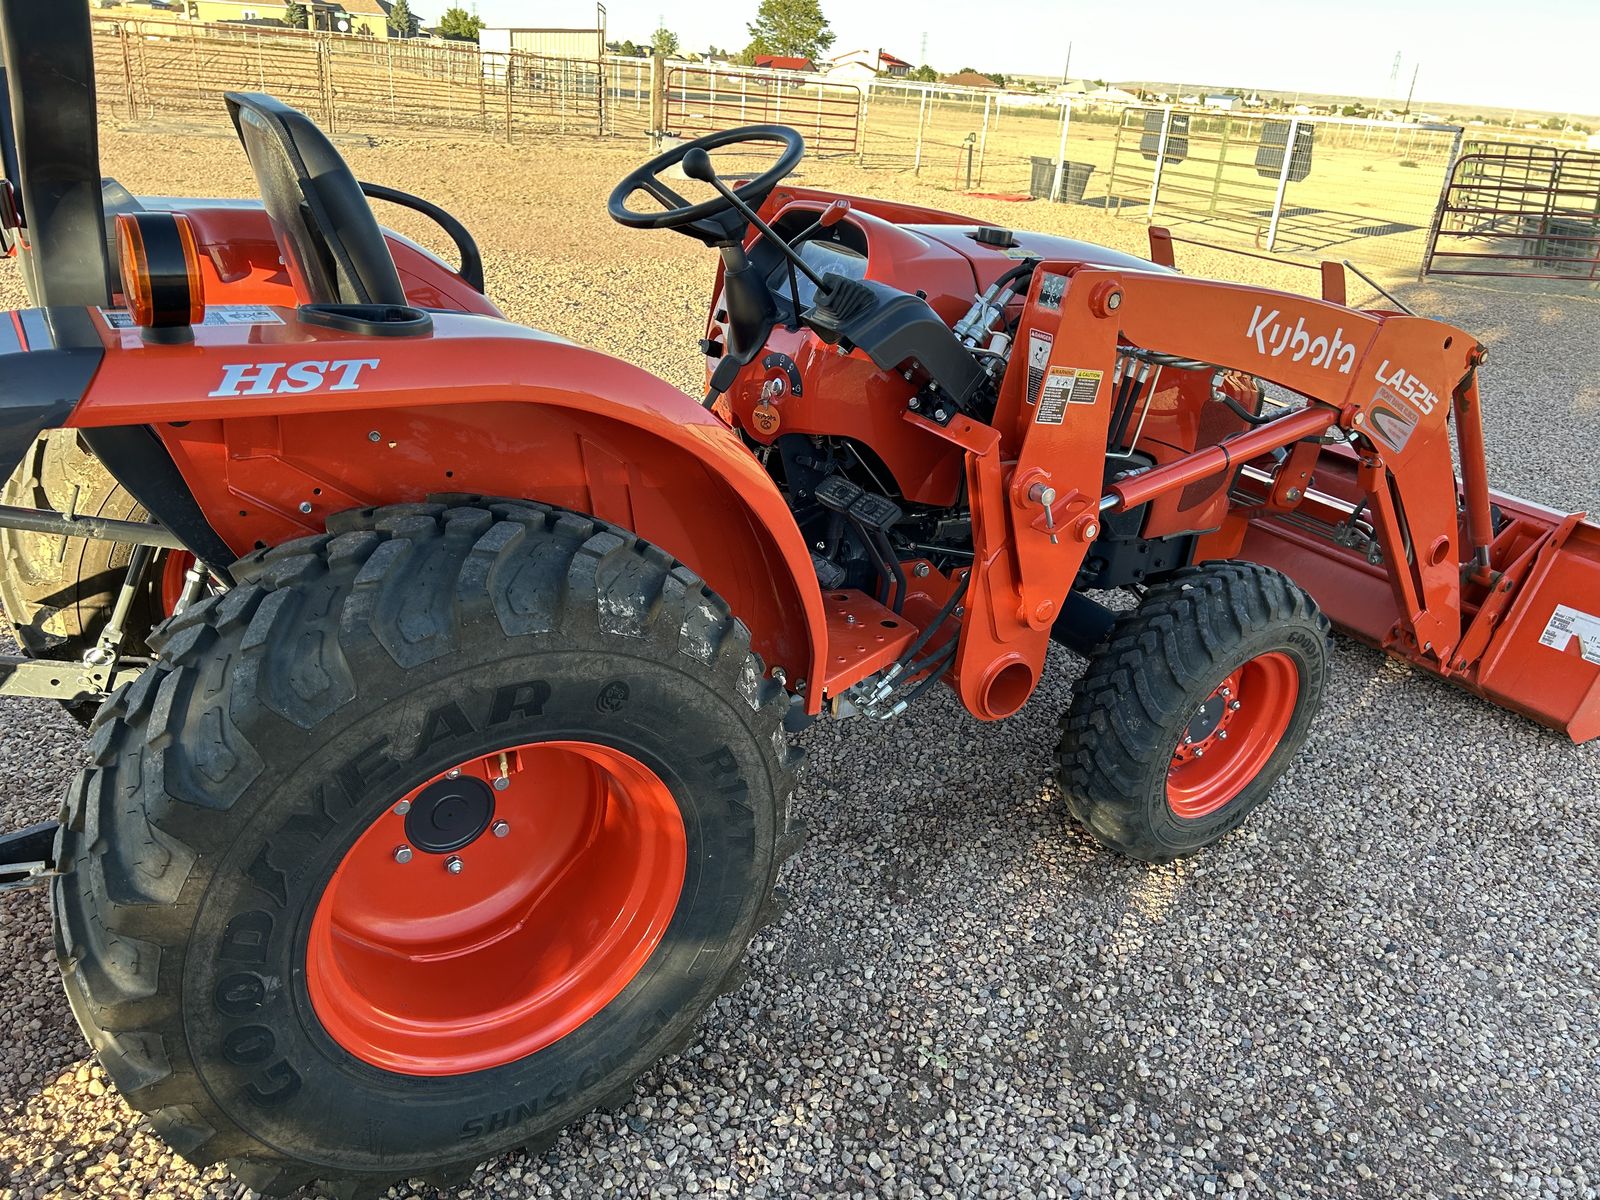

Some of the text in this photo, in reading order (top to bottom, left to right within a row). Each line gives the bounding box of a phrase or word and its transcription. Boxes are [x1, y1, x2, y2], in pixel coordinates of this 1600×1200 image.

[1246, 305, 1356, 374] Kubota
[208, 358, 380, 397] HST
[1055, 368, 1074, 376] WARNING
[1375, 360, 1439, 415] LA525
[215, 679, 551, 1108] GOODYEAR
